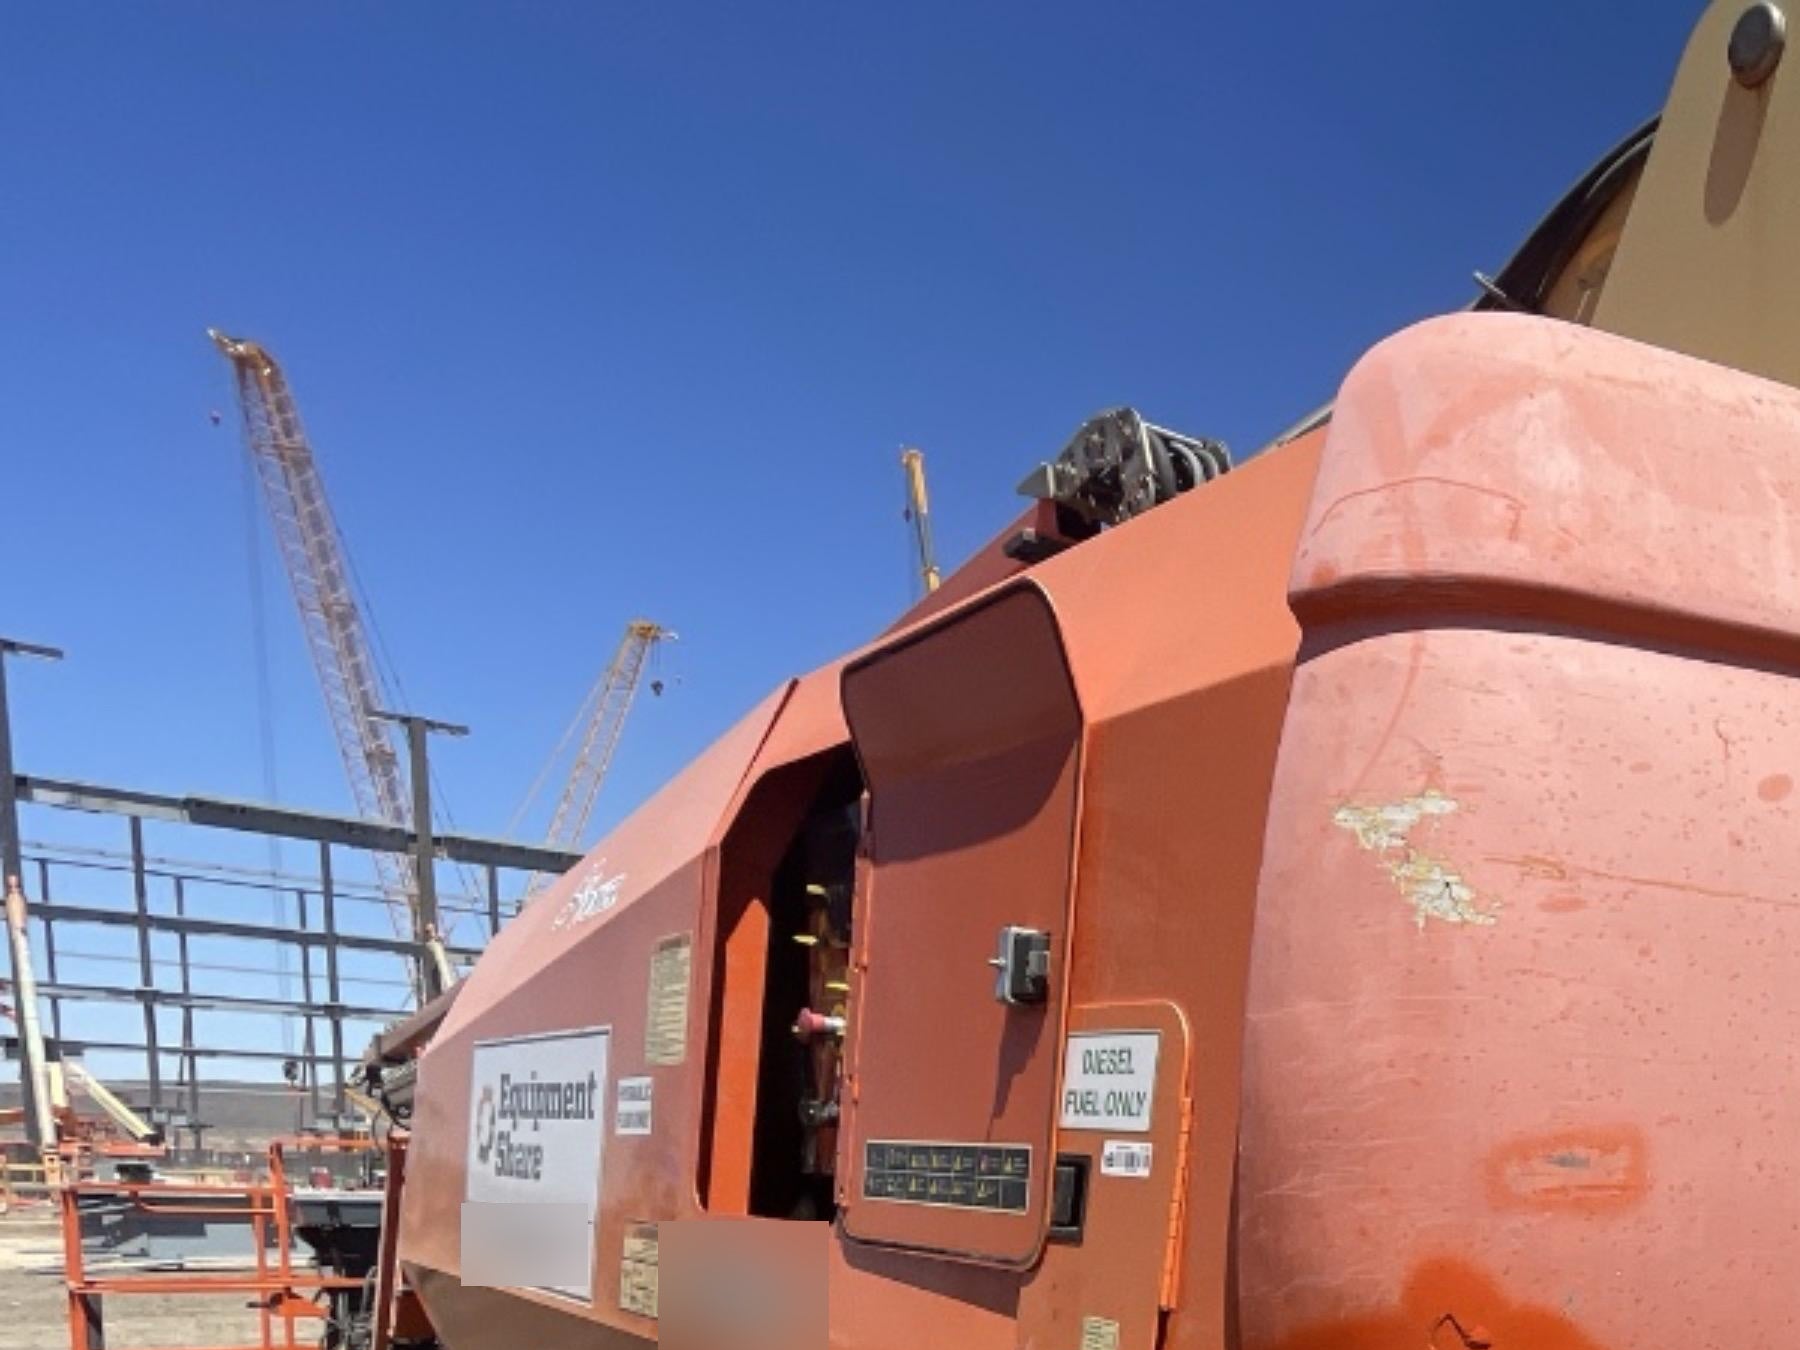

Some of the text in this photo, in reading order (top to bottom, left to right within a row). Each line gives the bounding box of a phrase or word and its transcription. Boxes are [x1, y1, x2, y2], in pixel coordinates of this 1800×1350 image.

[1082, 1047, 1135, 1075] DIESEL
[498, 1071, 597, 1131] Equipment
[1065, 1089, 1147, 1117] FUEL ONLY
[495, 1131, 543, 1180] Share
